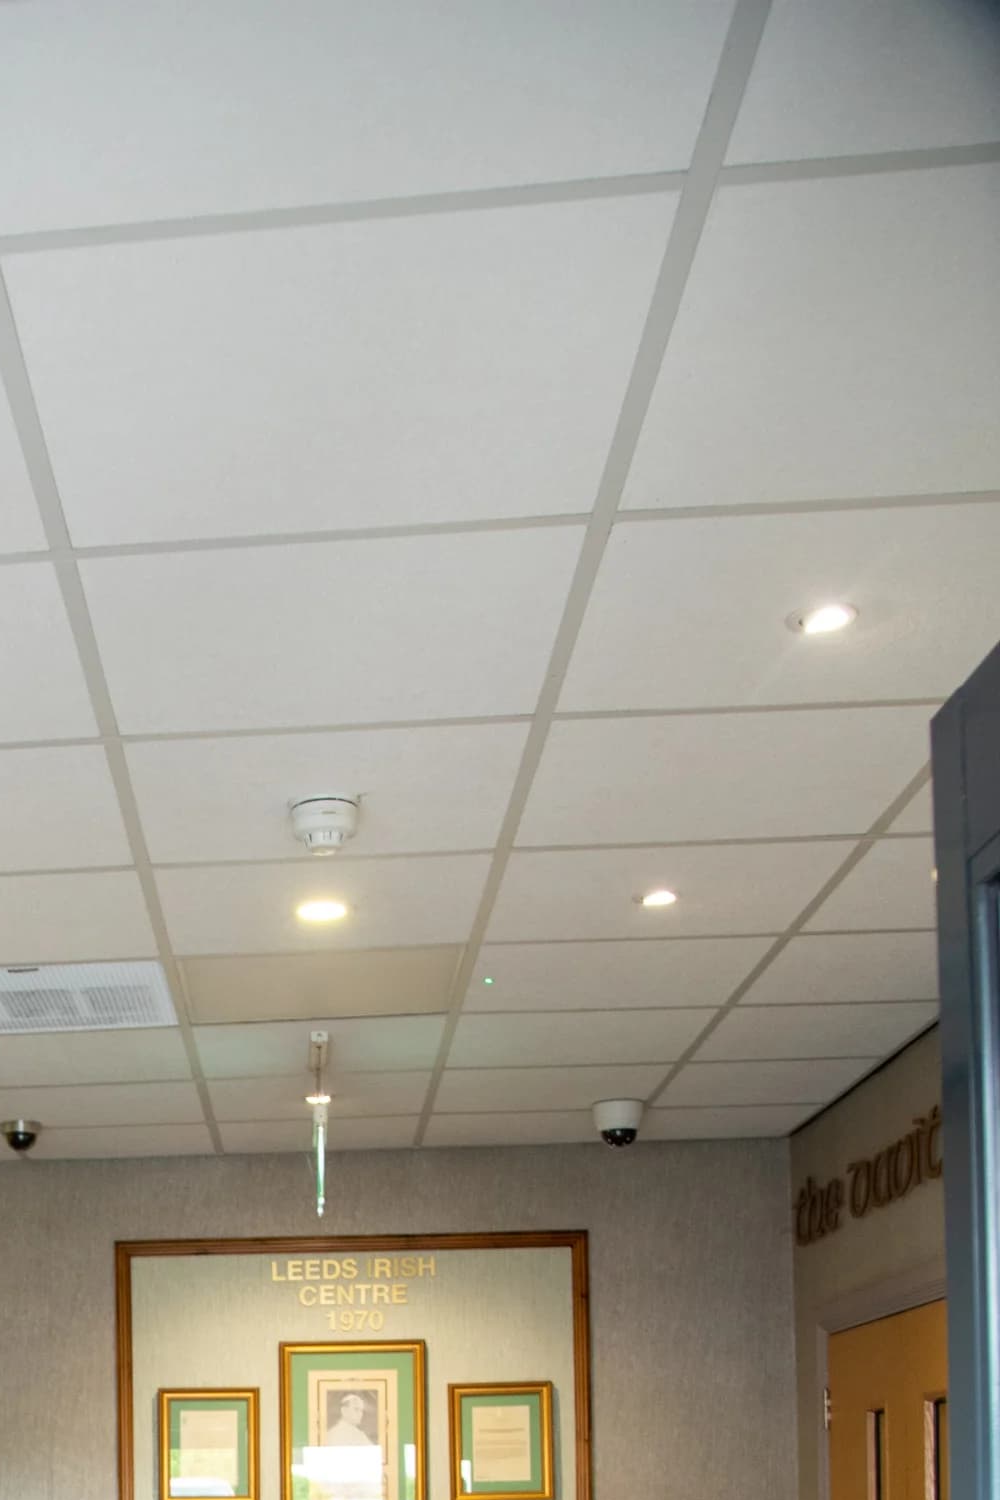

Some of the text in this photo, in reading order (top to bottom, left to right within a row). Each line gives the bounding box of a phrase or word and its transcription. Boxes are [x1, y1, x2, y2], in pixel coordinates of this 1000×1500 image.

[271, 1255, 437, 1281] LEEDS IRISH
[299, 1283, 409, 1307] CENTRE
[326, 1310, 385, 1331] 1970
